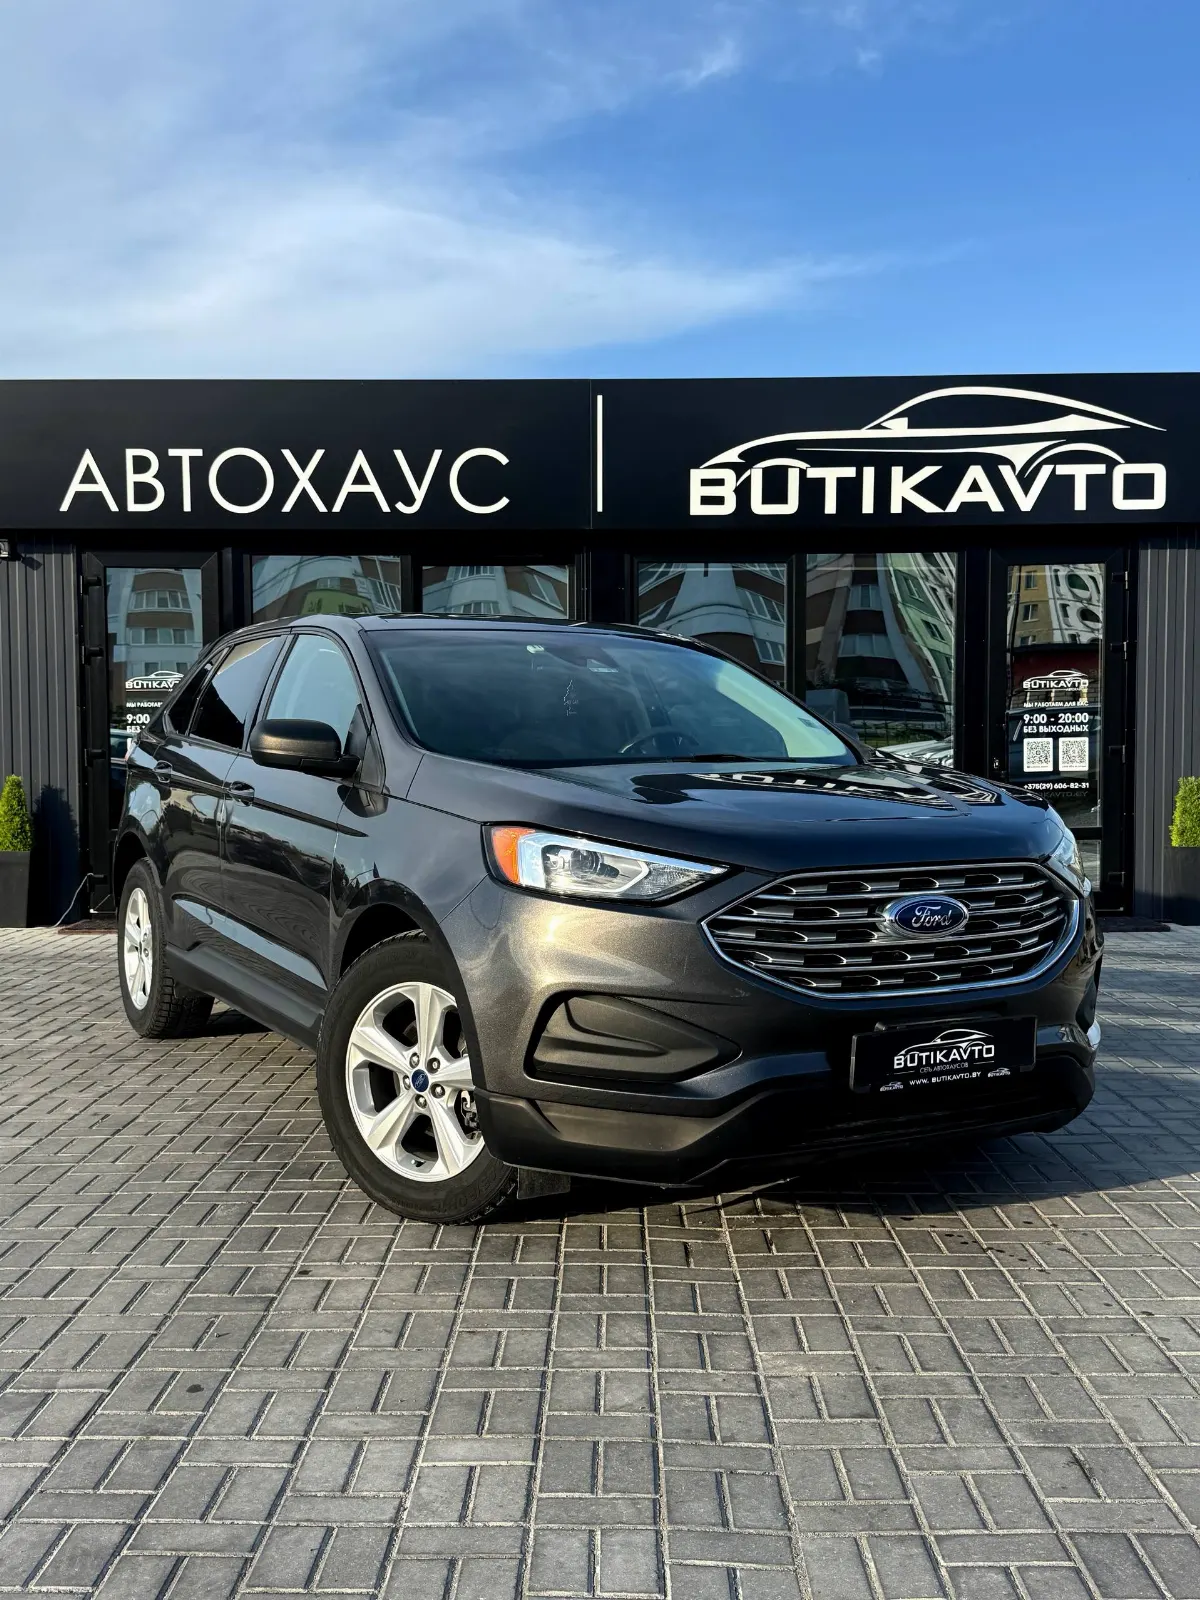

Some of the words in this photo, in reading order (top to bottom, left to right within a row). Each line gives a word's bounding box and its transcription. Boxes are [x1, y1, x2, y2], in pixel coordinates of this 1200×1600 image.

[59, 447, 510, 515] АВТОХАУС
[690, 463, 1167, 516] BUTIKAVTO
[125, 680, 179, 689] BUTIKAV
[1023, 680, 1089, 689] BUTIKAVTO
[126, 714, 150, 724] 9:00
[1023, 713, 1047, 724] 9:00
[1058, 713, 1089, 723] 20:00
[126, 725, 141, 733] БЕЗ
[1023, 725, 1038, 733] БЕЗ
[1039, 724, 1089, 733] ВЫХОДНЫХ
[911, 905, 952, 928] Ford
[894, 1044, 995, 1069] BUTIKAVTO
[919, 1066, 933, 1074] СЕТЬ
[933, 1062, 969, 1073] АВТОХАУСОВ
[909, 1078, 930, 1086] WWW.
[931, 1071, 982, 1083] BUTIKAVTO.BY
